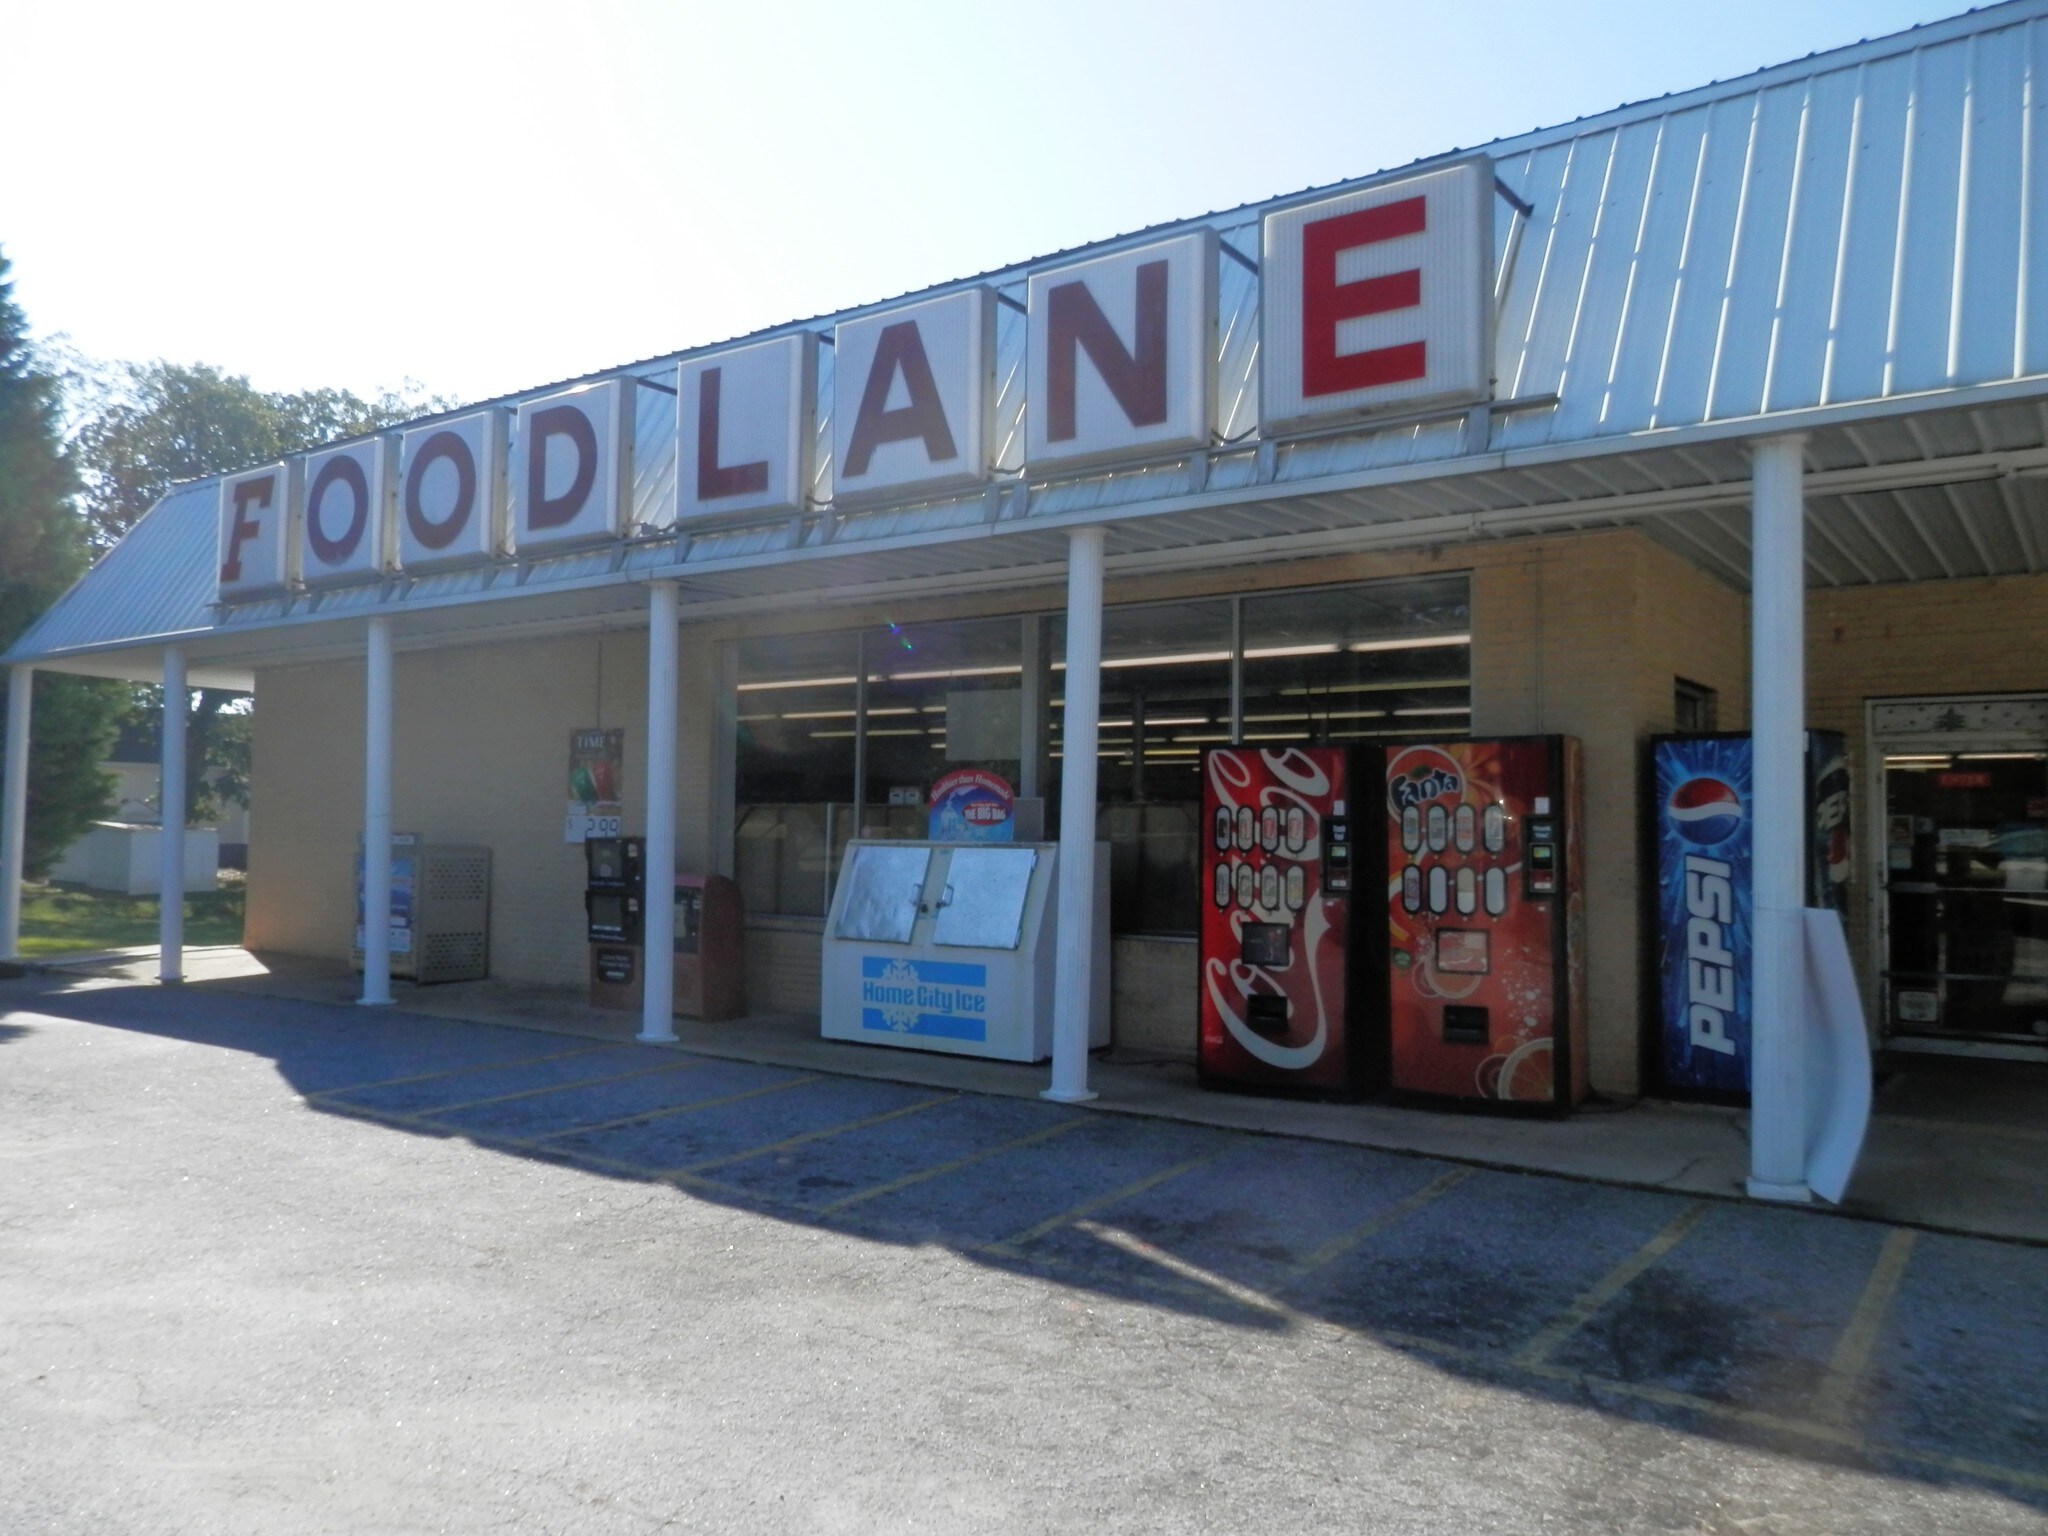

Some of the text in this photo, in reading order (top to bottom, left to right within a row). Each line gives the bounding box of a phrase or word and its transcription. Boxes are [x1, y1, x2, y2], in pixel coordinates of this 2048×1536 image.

[220, 195, 1427, 582] FOOD LANE
[576, 736, 606, 748] TIME
[1389, 768, 1460, 808] Fanta
[964, 807, 1006, 820] THE BIG BAG
[1686, 856, 1736, 1056] PEPSI
[863, 981, 986, 1014] Home City Ice
